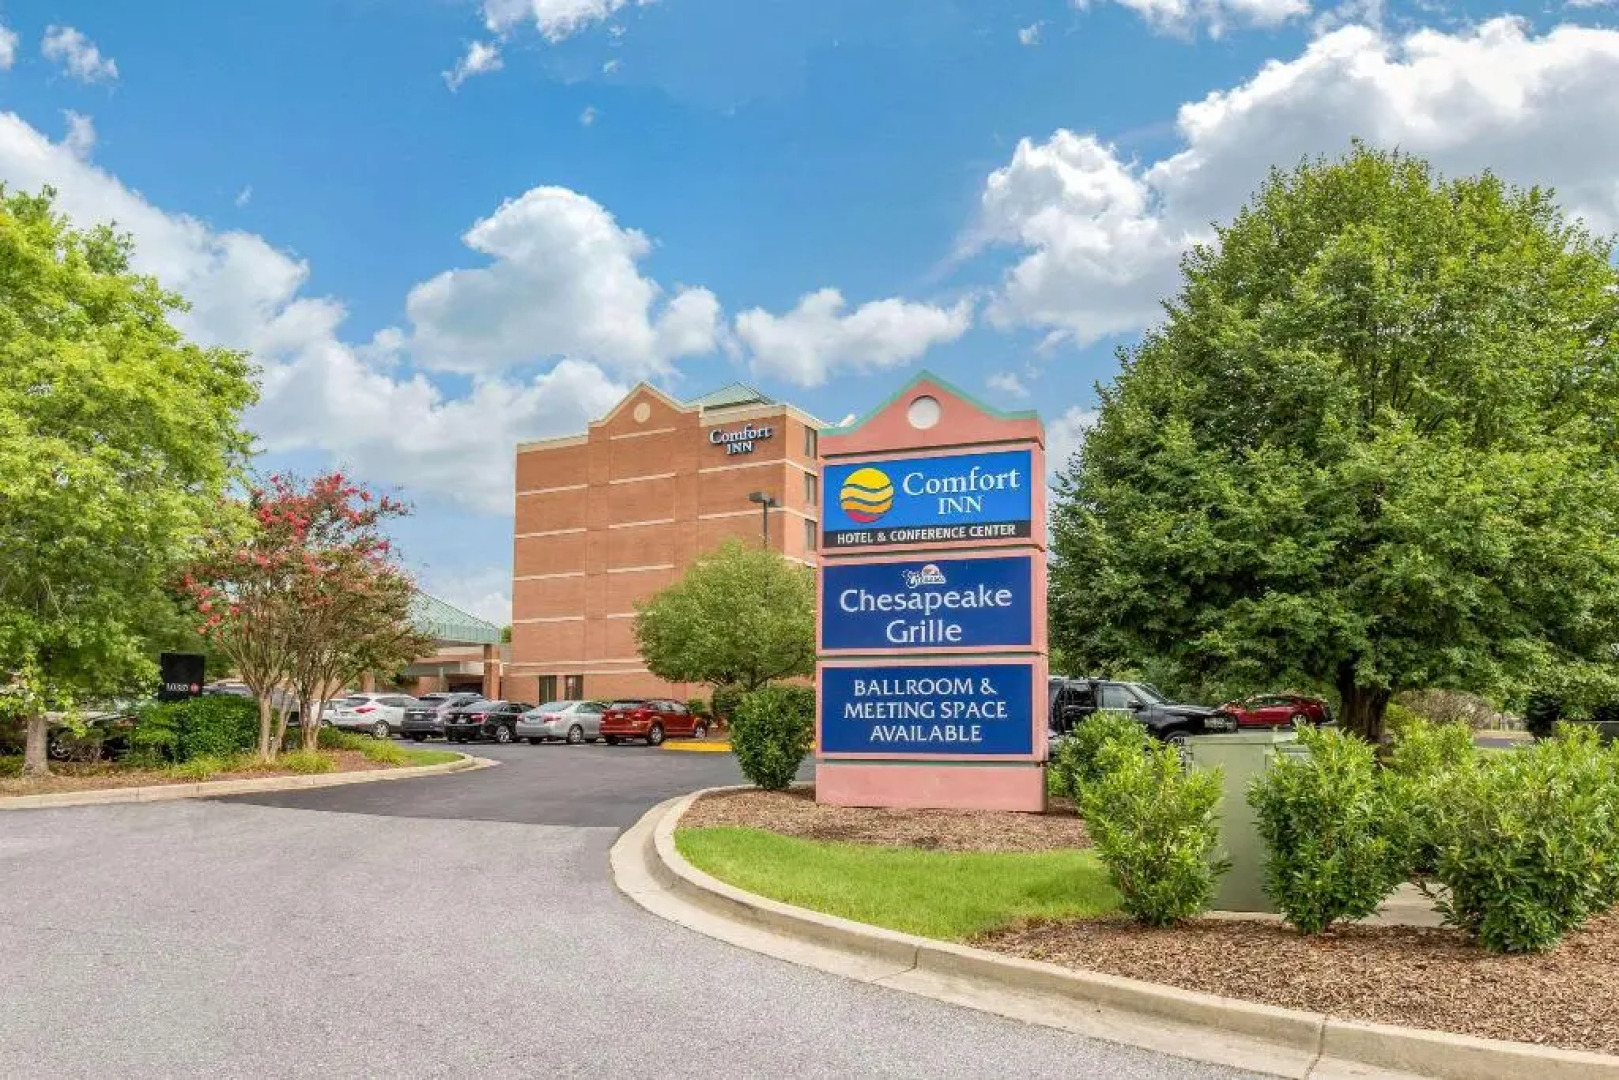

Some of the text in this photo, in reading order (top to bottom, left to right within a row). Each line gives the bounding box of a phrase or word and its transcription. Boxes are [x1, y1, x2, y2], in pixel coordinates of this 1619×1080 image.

[709, 423, 772, 444] Comfort
[726, 440, 752, 455] INN
[902, 465, 1020, 496] Comfort
[937, 495, 982, 515] INN
[837, 524, 1016, 544] HOTEL & CONFERENCE CENTER
[840, 584, 1013, 615] Chesapeake
[886, 619, 962, 643] Grille
[854, 678, 998, 696] BALLROOM &
[844, 701, 1008, 719] MEETING SPACE
[870, 725, 983, 742] AVAILABLE
